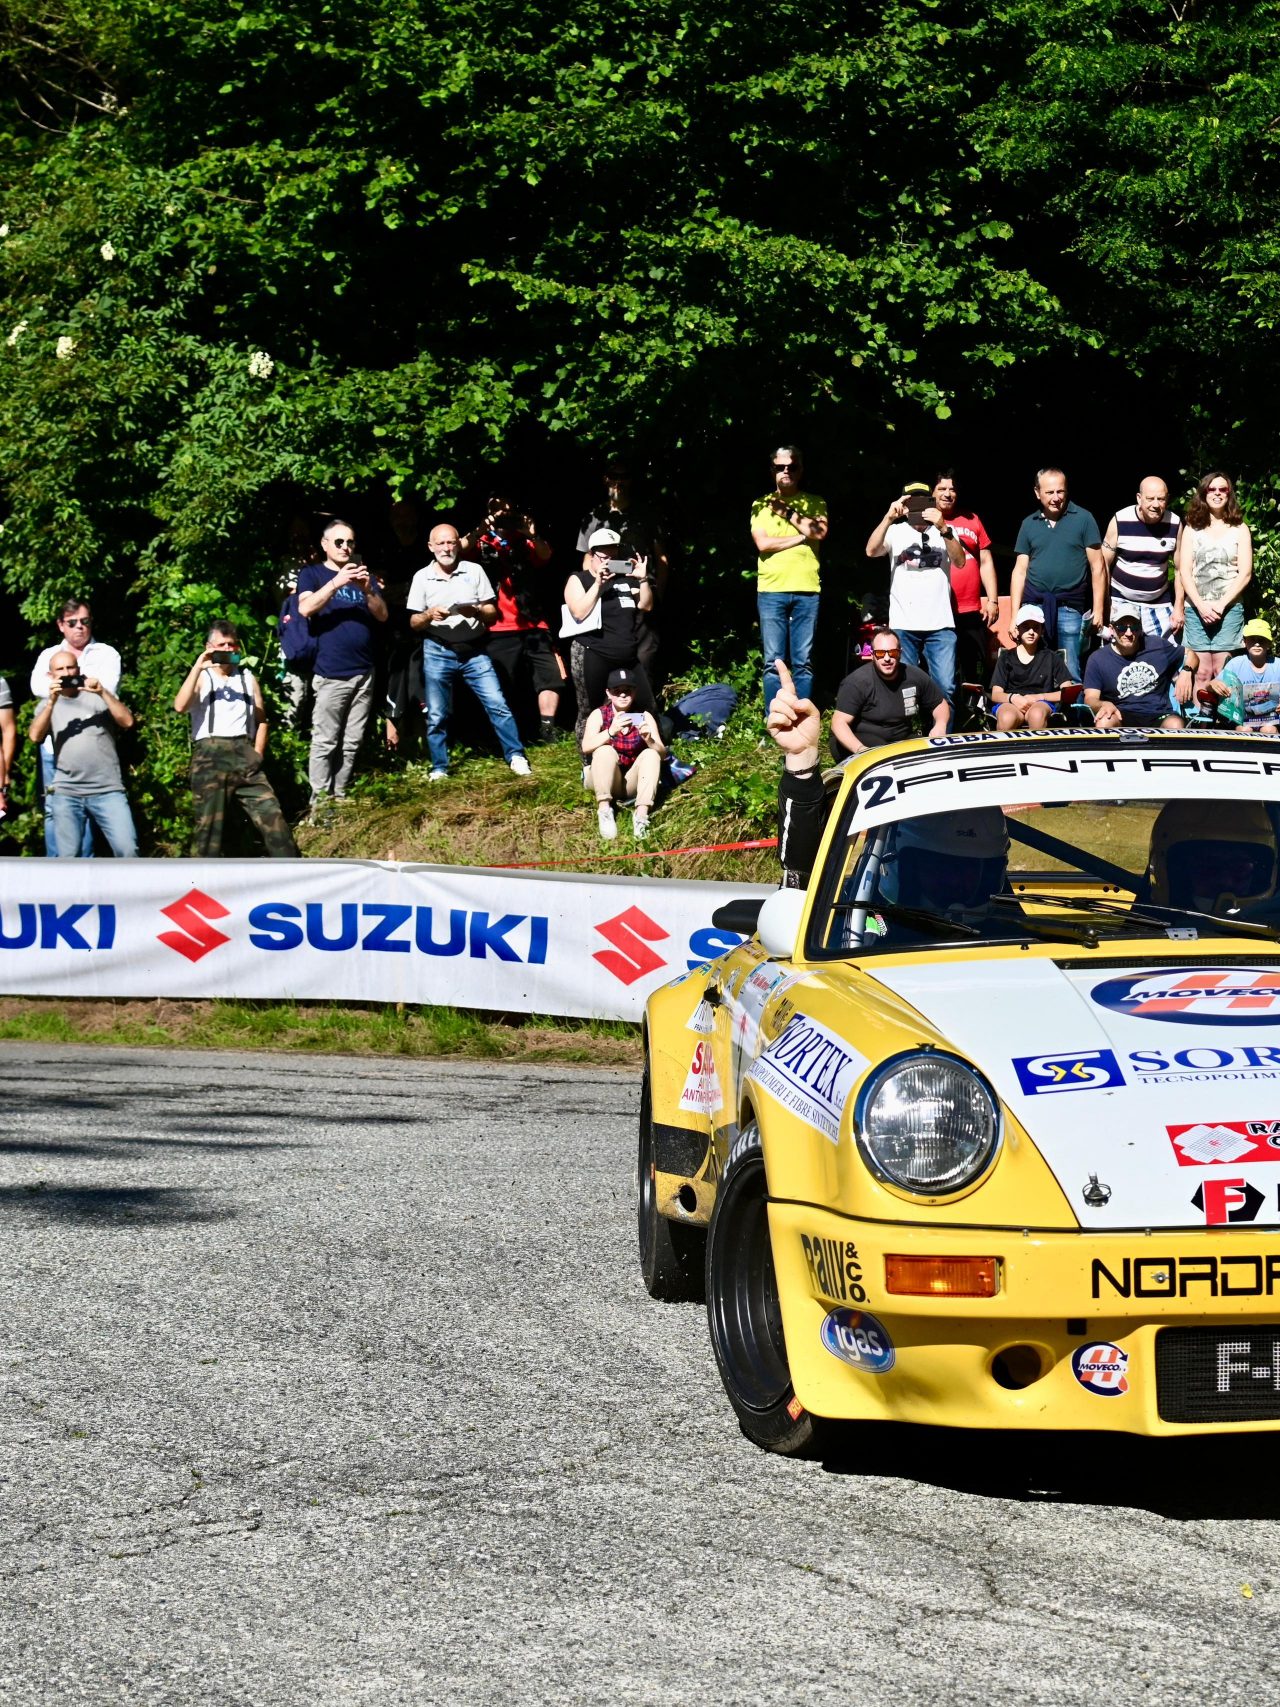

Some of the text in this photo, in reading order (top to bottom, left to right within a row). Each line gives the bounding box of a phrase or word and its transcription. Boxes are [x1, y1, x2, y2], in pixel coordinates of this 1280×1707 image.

[929, 733, 997, 746] CEBA
[861, 775, 897, 810] 2
[249, 902, 549, 966] SUZUKI
[801, 1233, 847, 1300] Rally
[834, 1315, 883, 1361] igas
